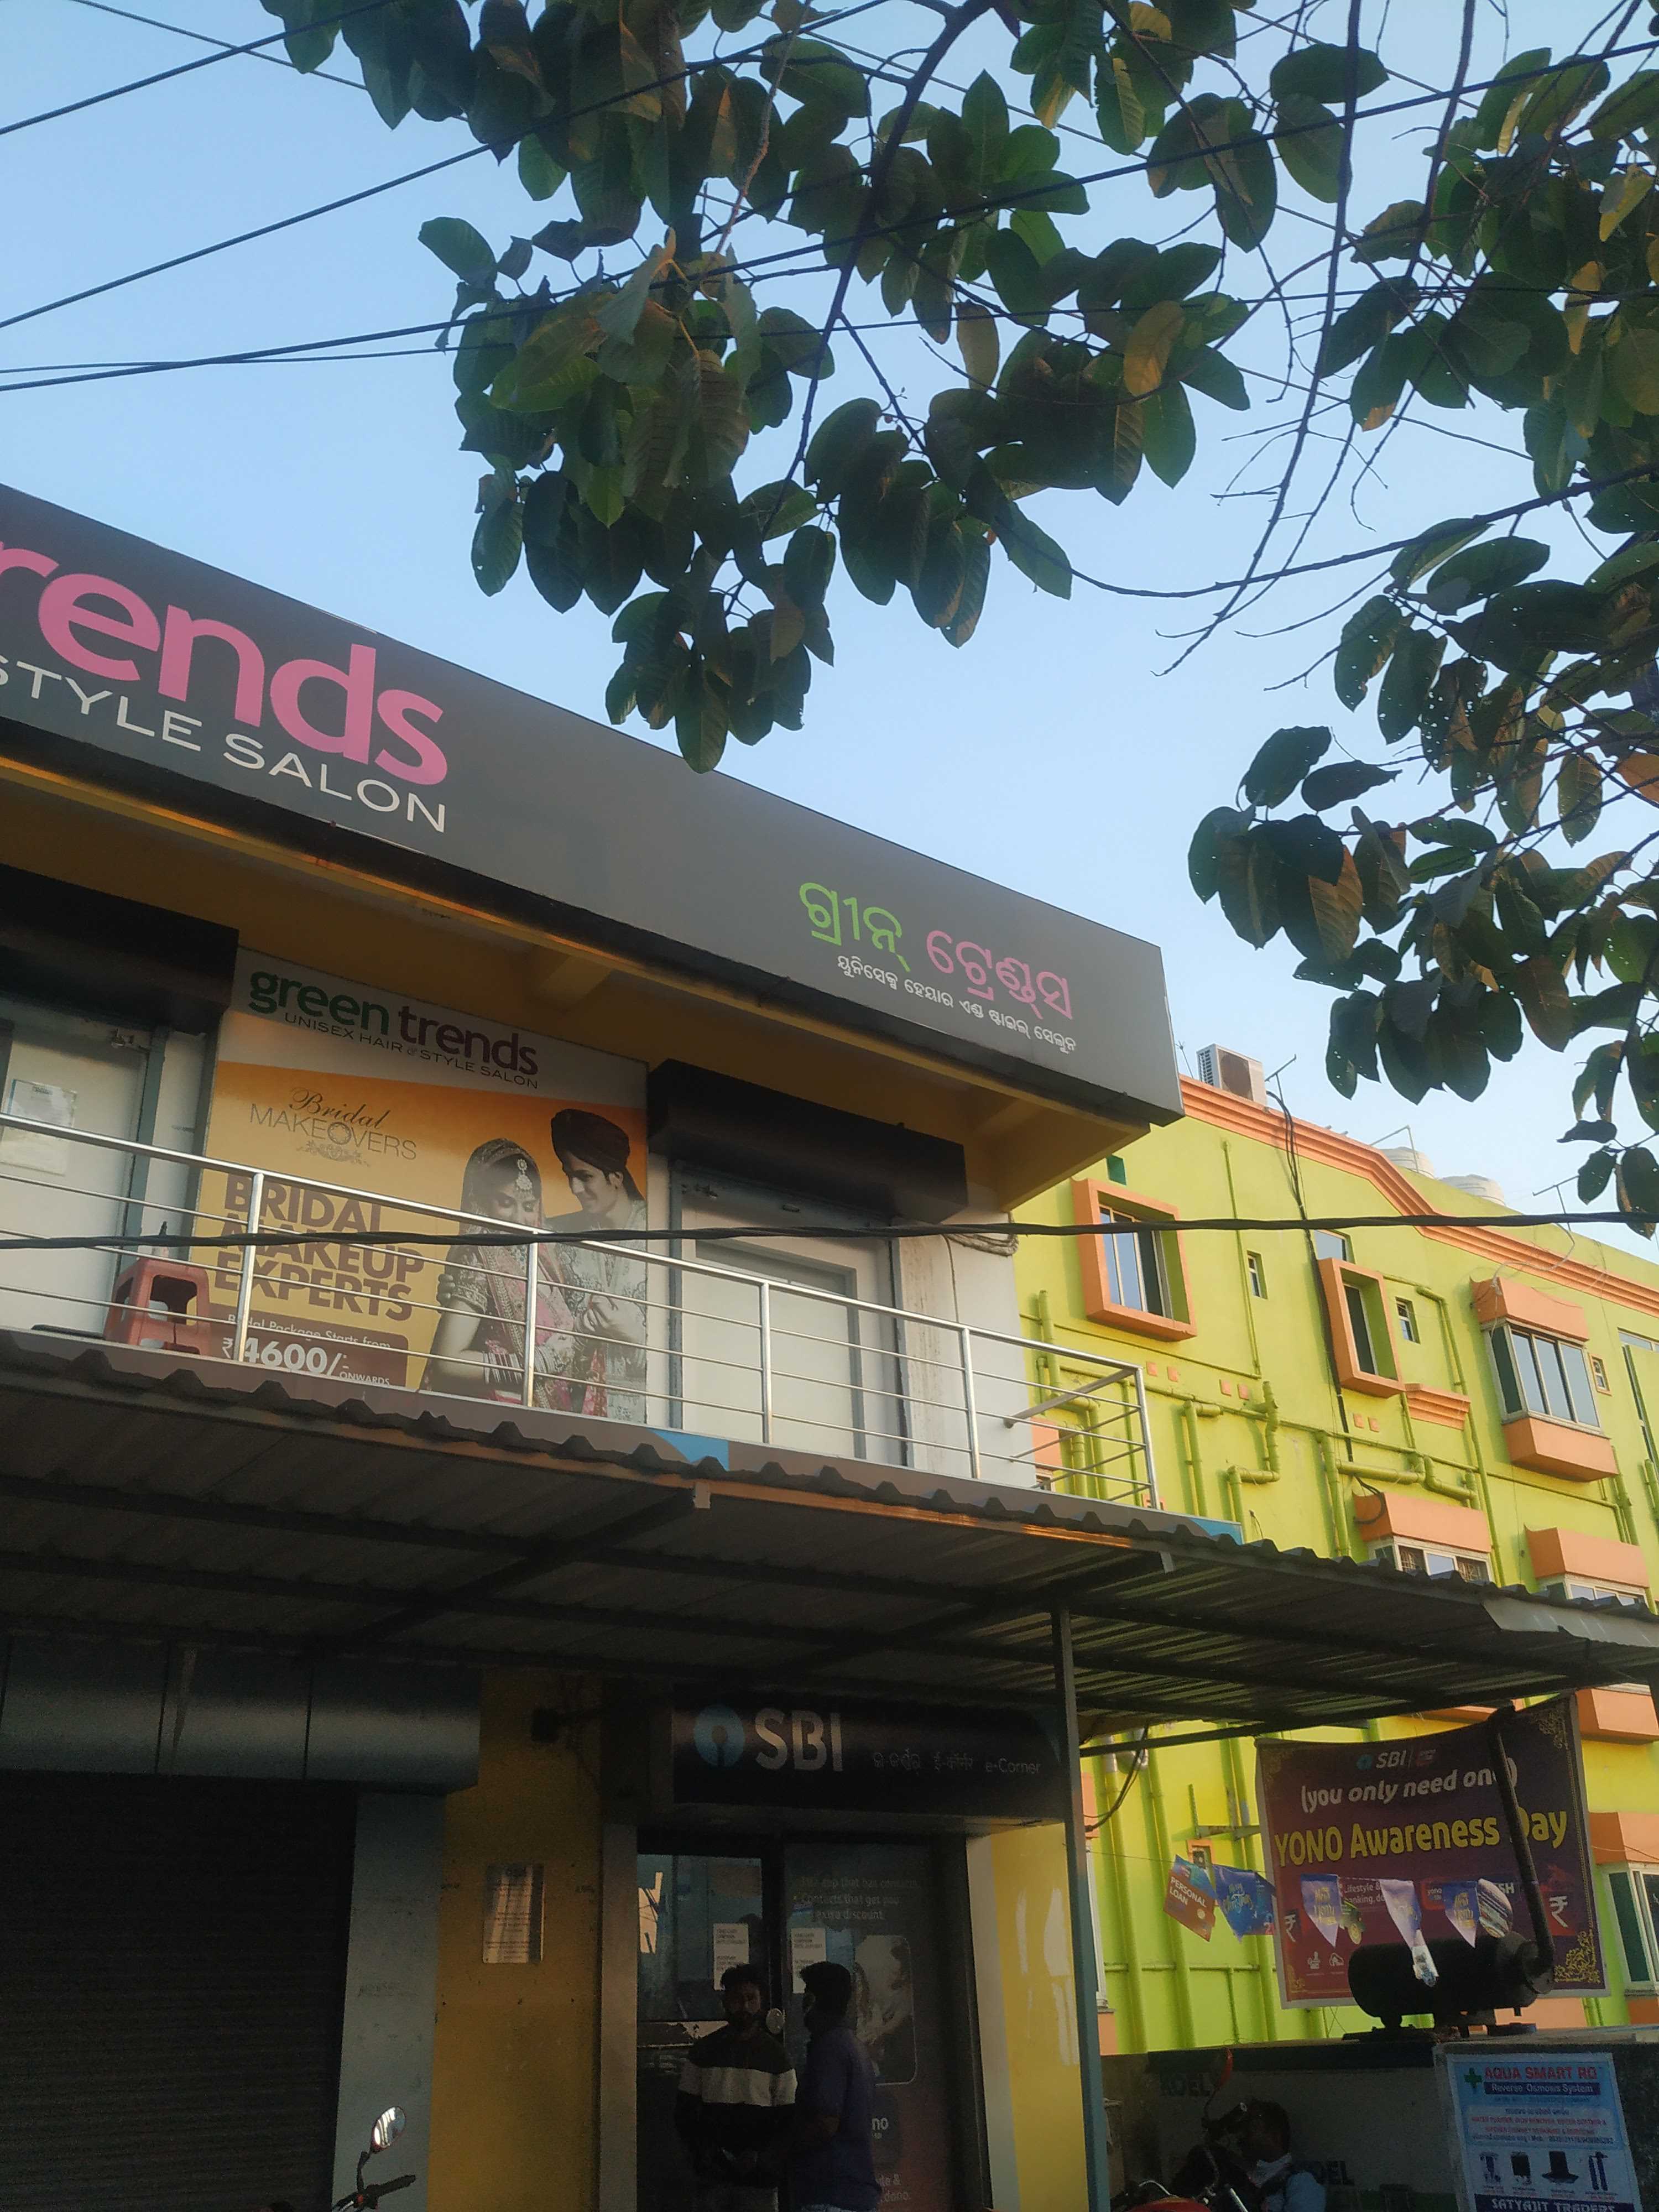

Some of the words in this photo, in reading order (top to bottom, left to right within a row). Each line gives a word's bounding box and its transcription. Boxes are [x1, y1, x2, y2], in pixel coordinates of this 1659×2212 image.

[223, 733, 445, 834] SALON
[248, 971, 390, 1036] green
[398, 1005, 539, 1076] trends
[284, 1012, 355, 1041] UNISEX
[359, 1034, 403, 1053] HAIR
[419, 1050, 476, 1072] STYLE
[480, 1065, 539, 1089] SALON
[249, 1103, 418, 1161] MAKEOVERS
[289, 1087, 392, 1130] Bridal
[214, 1251, 413, 1322] EXPERTS
[227, 1314, 265, 1329] Bdal
[755, 1708, 843, 1771] SBI
[1375, 1749, 1407, 1770] SBI
[985, 1757, 1041, 1774] e-Corner
[1301, 1785, 1342, 1814] (you
[1348, 1780, 1398, 1804] only
[1403, 1769, 1458, 1797] need
[1463, 1756, 1517, 1789] on)
[1274, 1825, 1343, 1867] YONO
[1349, 1816, 1500, 1859] Awareness
[1169, 1886, 1188, 1906] LOAN
[1170, 1875, 1207, 1908] PERSONAL
[1485, 2066, 1521, 2080] AQUA
[1525, 2067, 1572, 2080] SMART
[1577, 2066, 1597, 2080] RO
[1562, 2083, 1593, 2094] System
